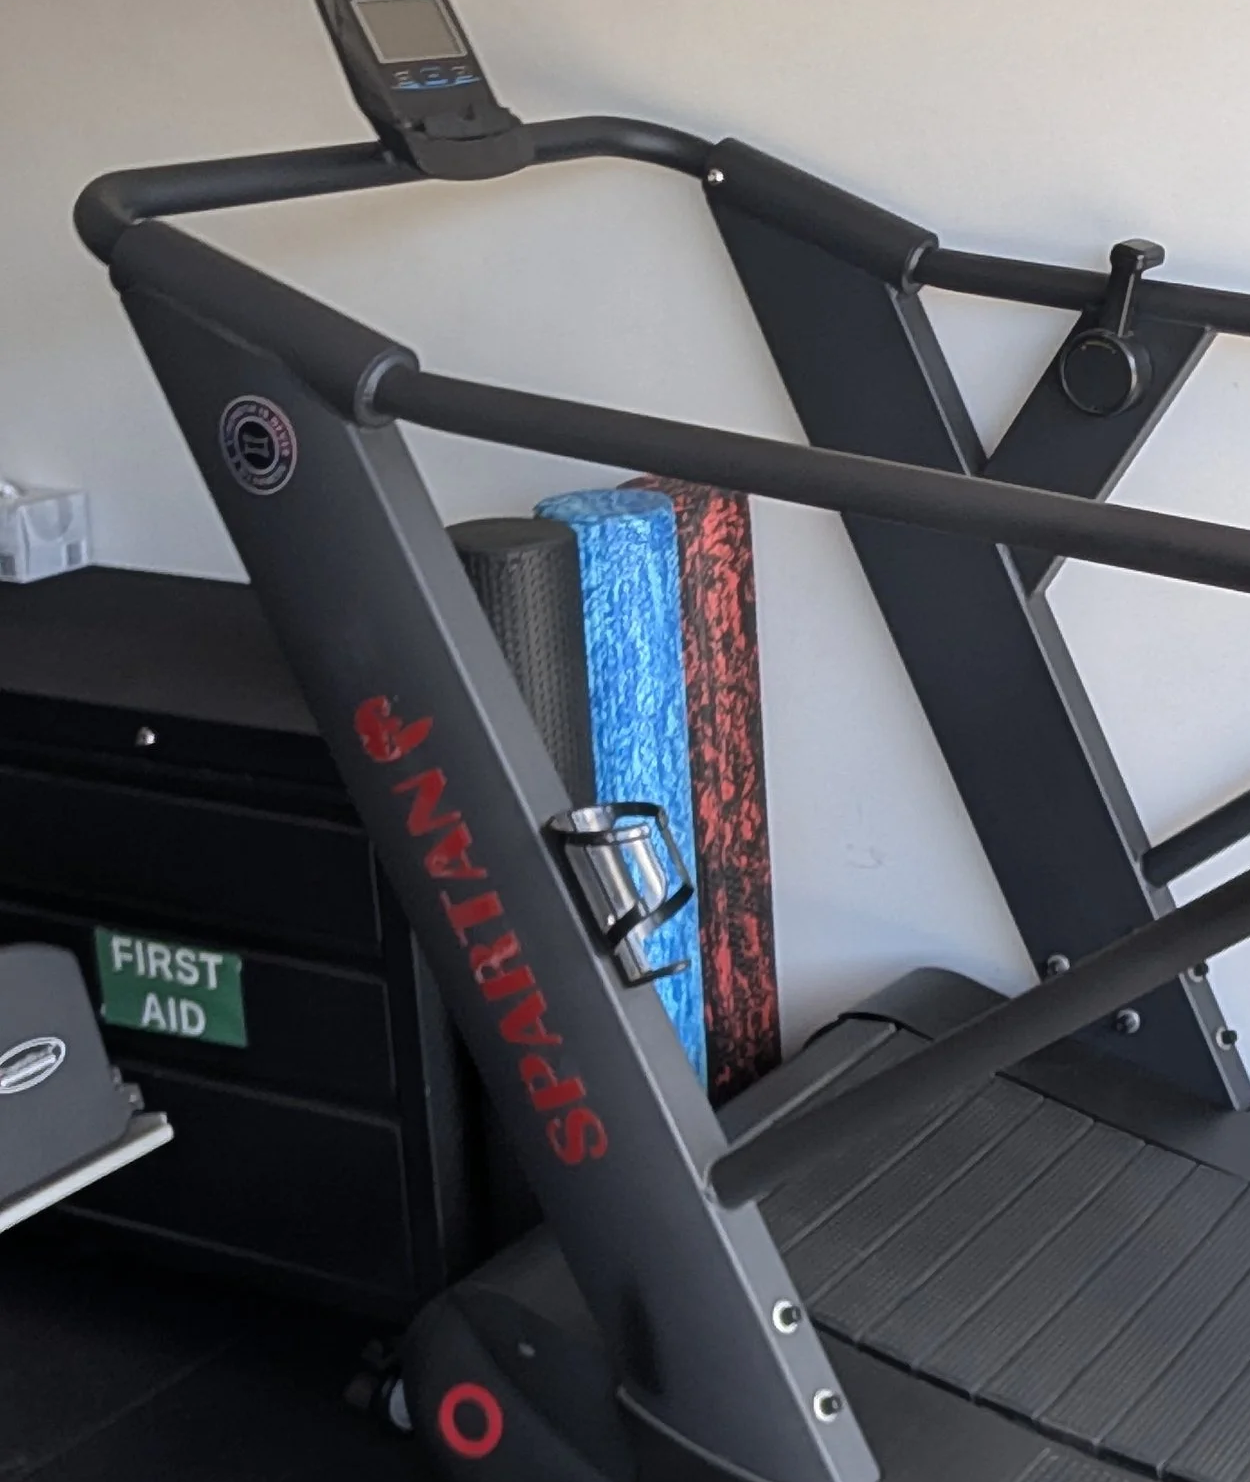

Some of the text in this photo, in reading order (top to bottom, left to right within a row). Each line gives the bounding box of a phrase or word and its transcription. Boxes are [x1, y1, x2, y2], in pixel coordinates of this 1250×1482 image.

[110, 934, 224, 992] FIRST
[392, 767, 608, 1166] SPARTAN
[140, 993, 207, 1037] AID
